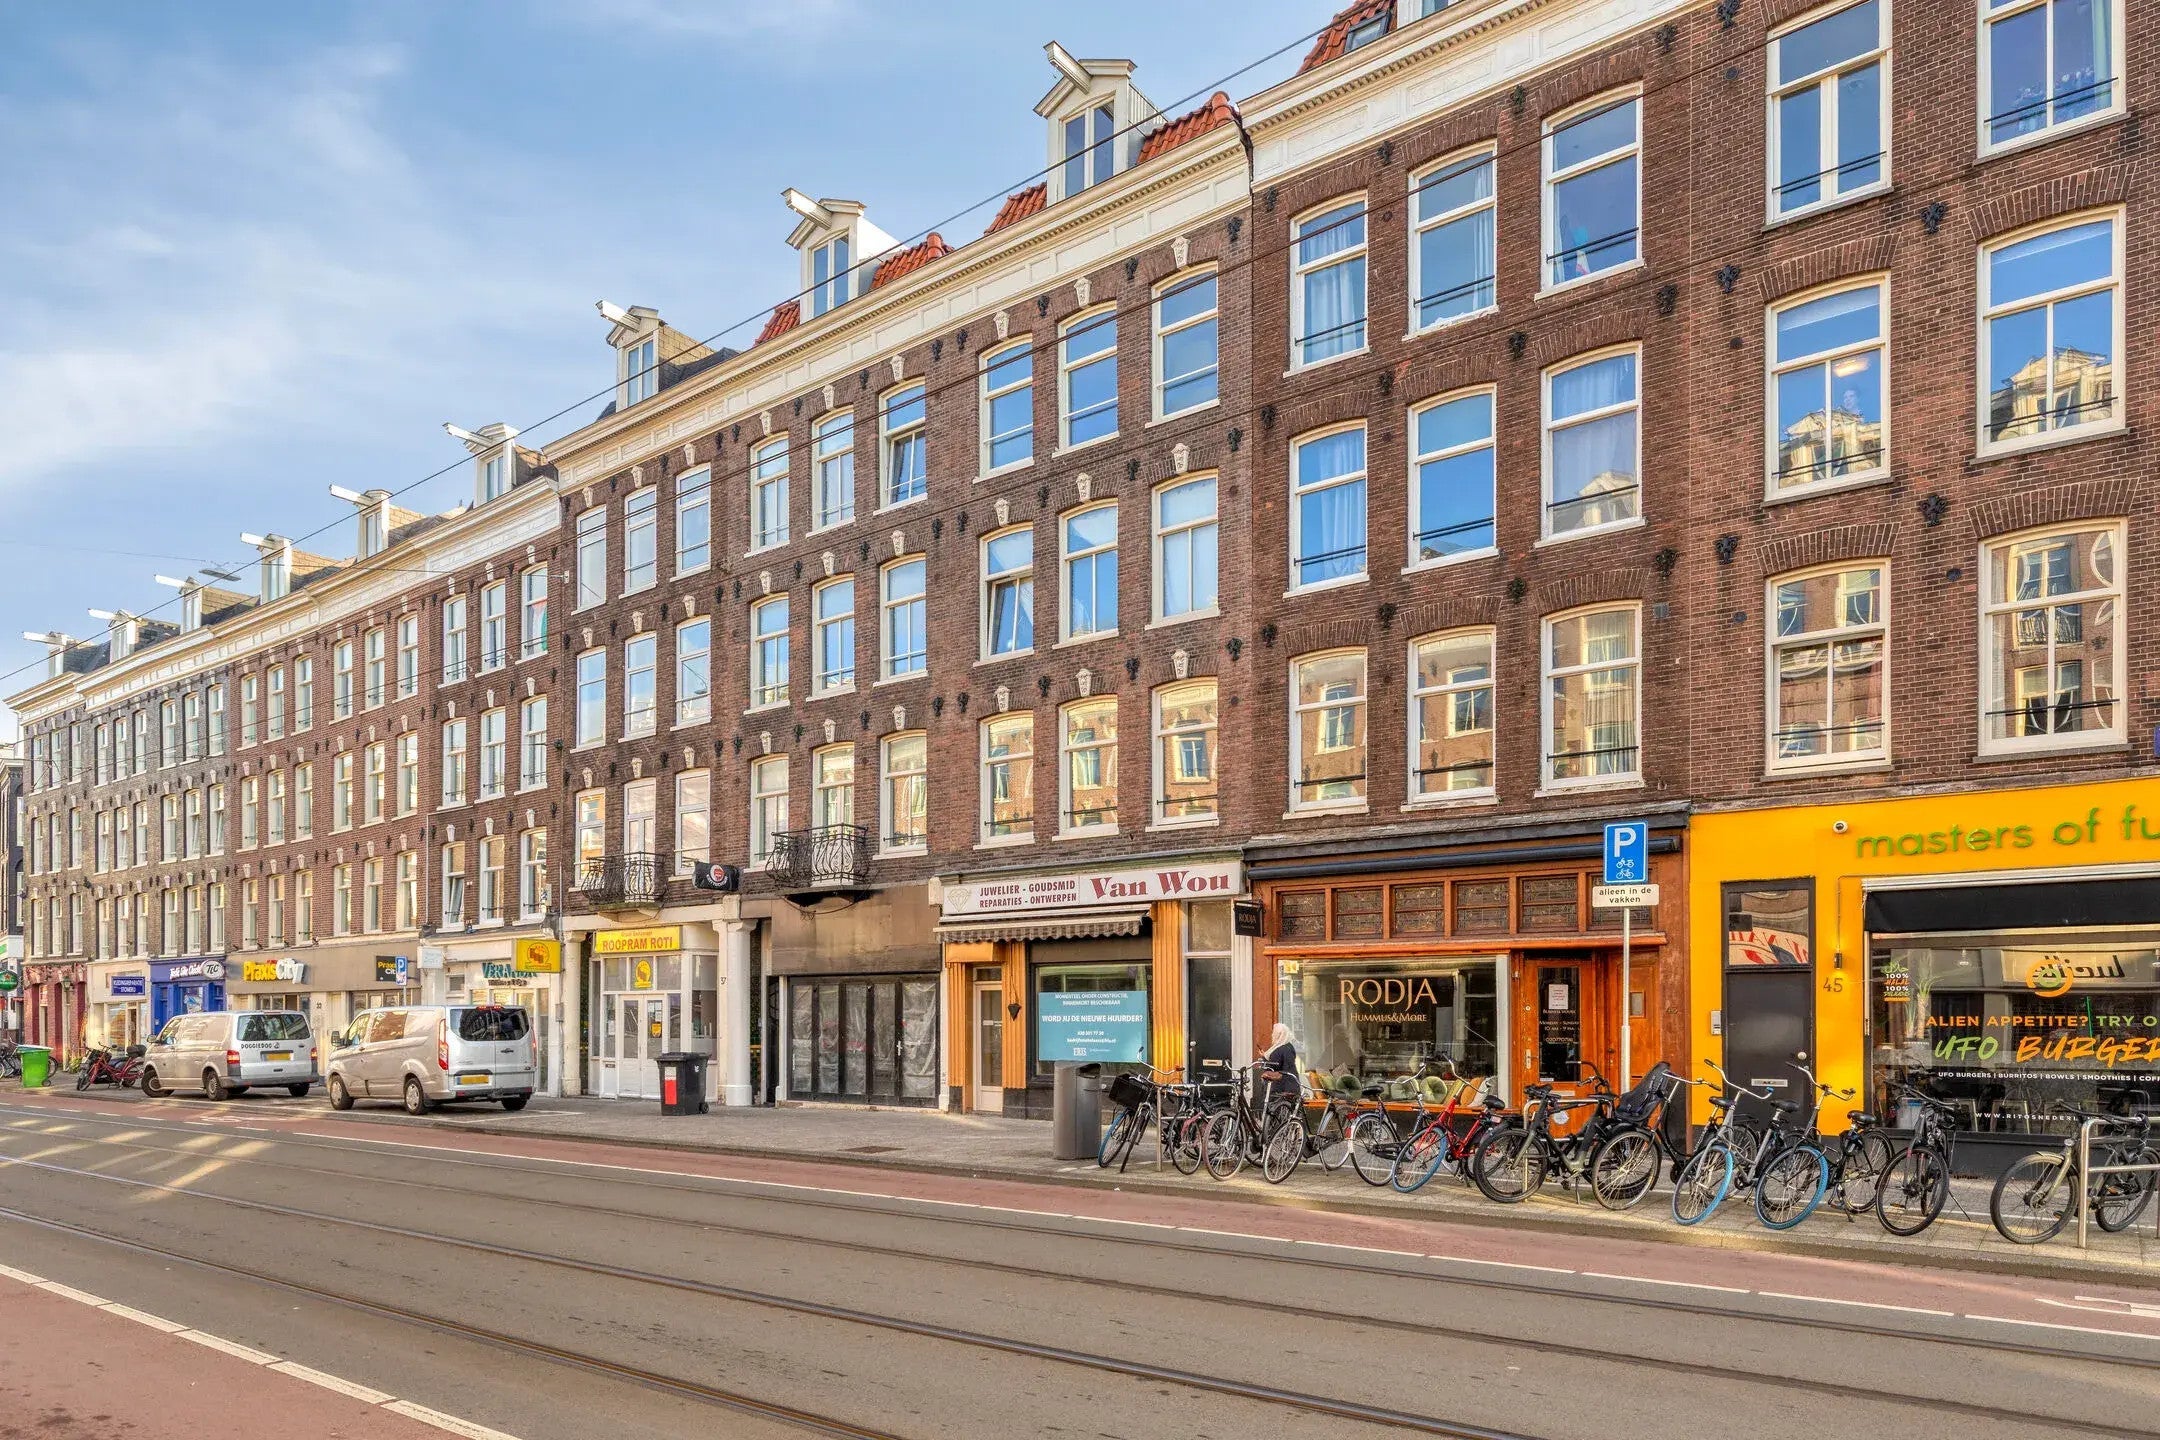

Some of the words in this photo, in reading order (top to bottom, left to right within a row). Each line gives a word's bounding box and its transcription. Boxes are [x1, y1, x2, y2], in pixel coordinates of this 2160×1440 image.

[1856, 823, 2034, 858] masters
[2053, 806, 2100, 845] of
[1614, 827, 1637, 858] P
[980, 884, 1020, 897] JUWELIER
[1028, 880, 1076, 893] GOUDSMID
[1090, 876, 1149, 899] Van
[1157, 870, 1230, 895] Wou
[1599, 888, 1626, 896] alleen
[1629, 887, 1638, 895] in
[1640, 886, 1652, 894] de
[979, 896, 1022, 908] REPARATIES
[1029, 893, 1077, 905] ONTWERPEN
[1609, 896, 1641, 904] vakken
[602, 937, 648, 952] ROOPRAM
[650, 936, 673, 950] ROTI
[397, 958, 405, 972] P
[1823, 976, 1843, 993] 45
[1340, 978, 1438, 1012] RODJA
[1107, 1014, 1143, 1022] HUURDER?
[1926, 1015, 1979, 1027] ALIEN
[1986, 1015, 2089, 1027] APPETITE?
[2095, 1015, 2134, 1027] TRY
[1935, 1035, 1999, 1061] UFO
